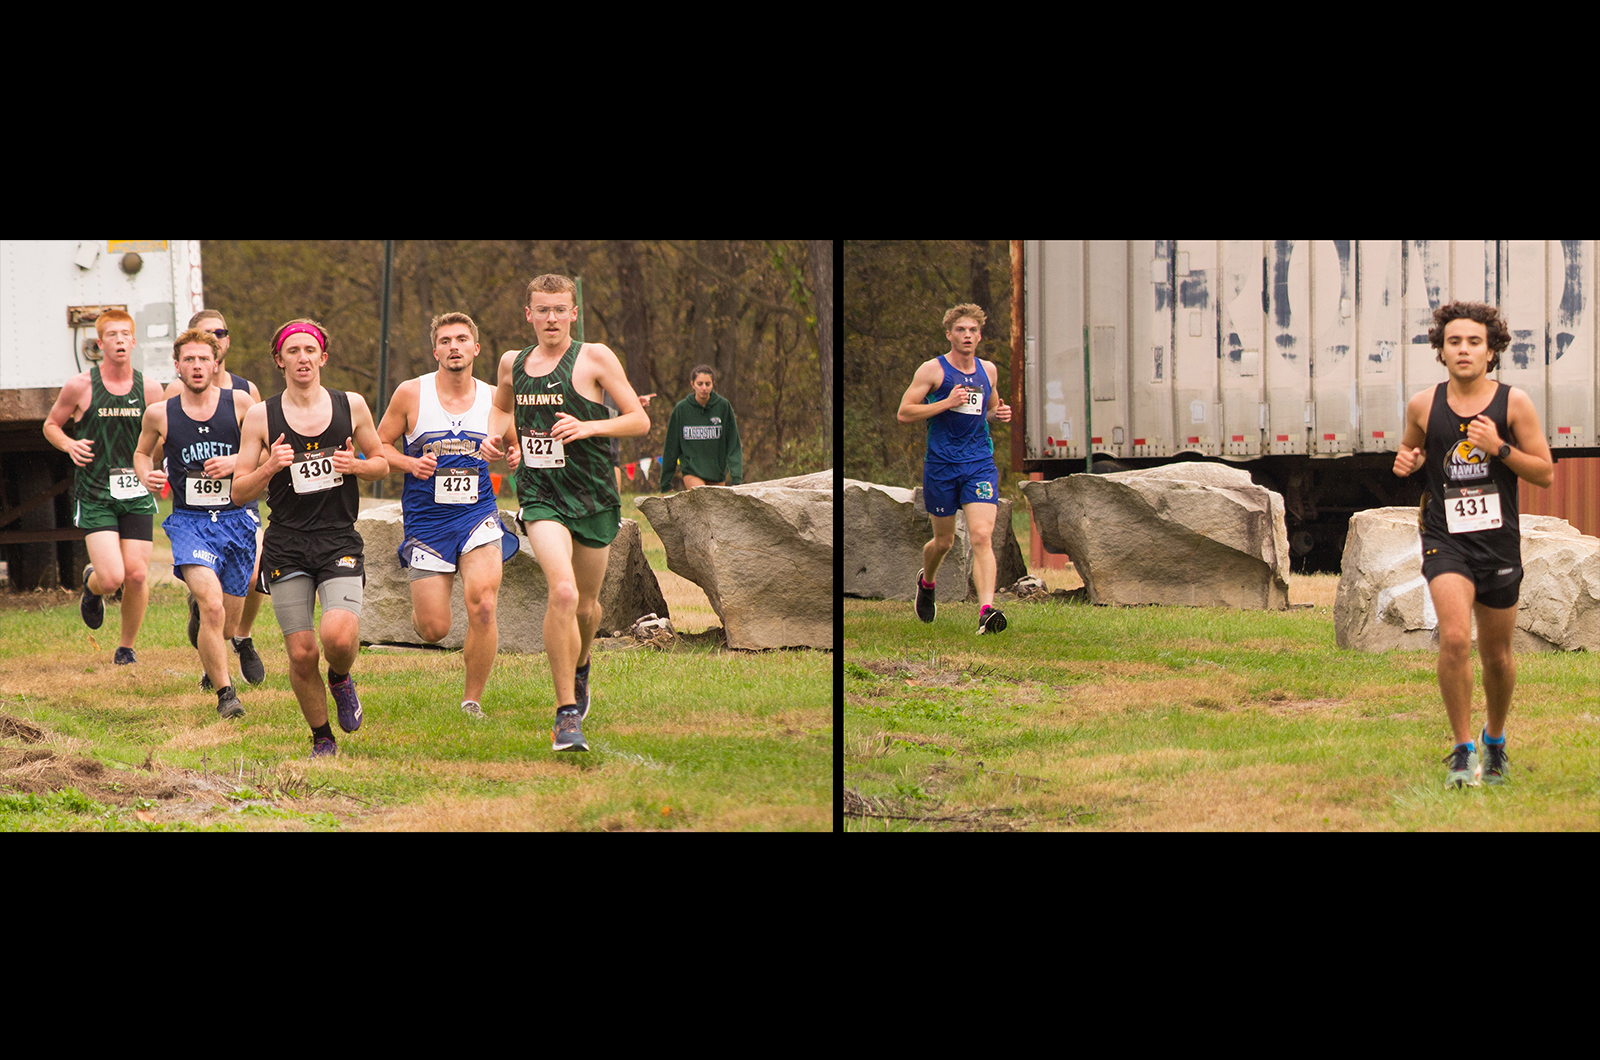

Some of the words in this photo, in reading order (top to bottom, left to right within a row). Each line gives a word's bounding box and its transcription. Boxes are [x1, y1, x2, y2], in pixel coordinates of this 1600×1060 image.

[516, 394, 564, 406] SEAHAWKS
[97, 408, 141, 417] SEAHAWKS
[181, 441, 233, 464] GARRETT
[526, 438, 553, 455] 427
[299, 458, 332, 479] 430
[1450, 462, 1488, 477] HAWKS
[117, 475, 140, 489] 429
[193, 480, 223, 494] 469
[443, 477, 471, 492] 473
[1454, 496, 1488, 517] 431
[192, 549, 218, 565] GARRETT
